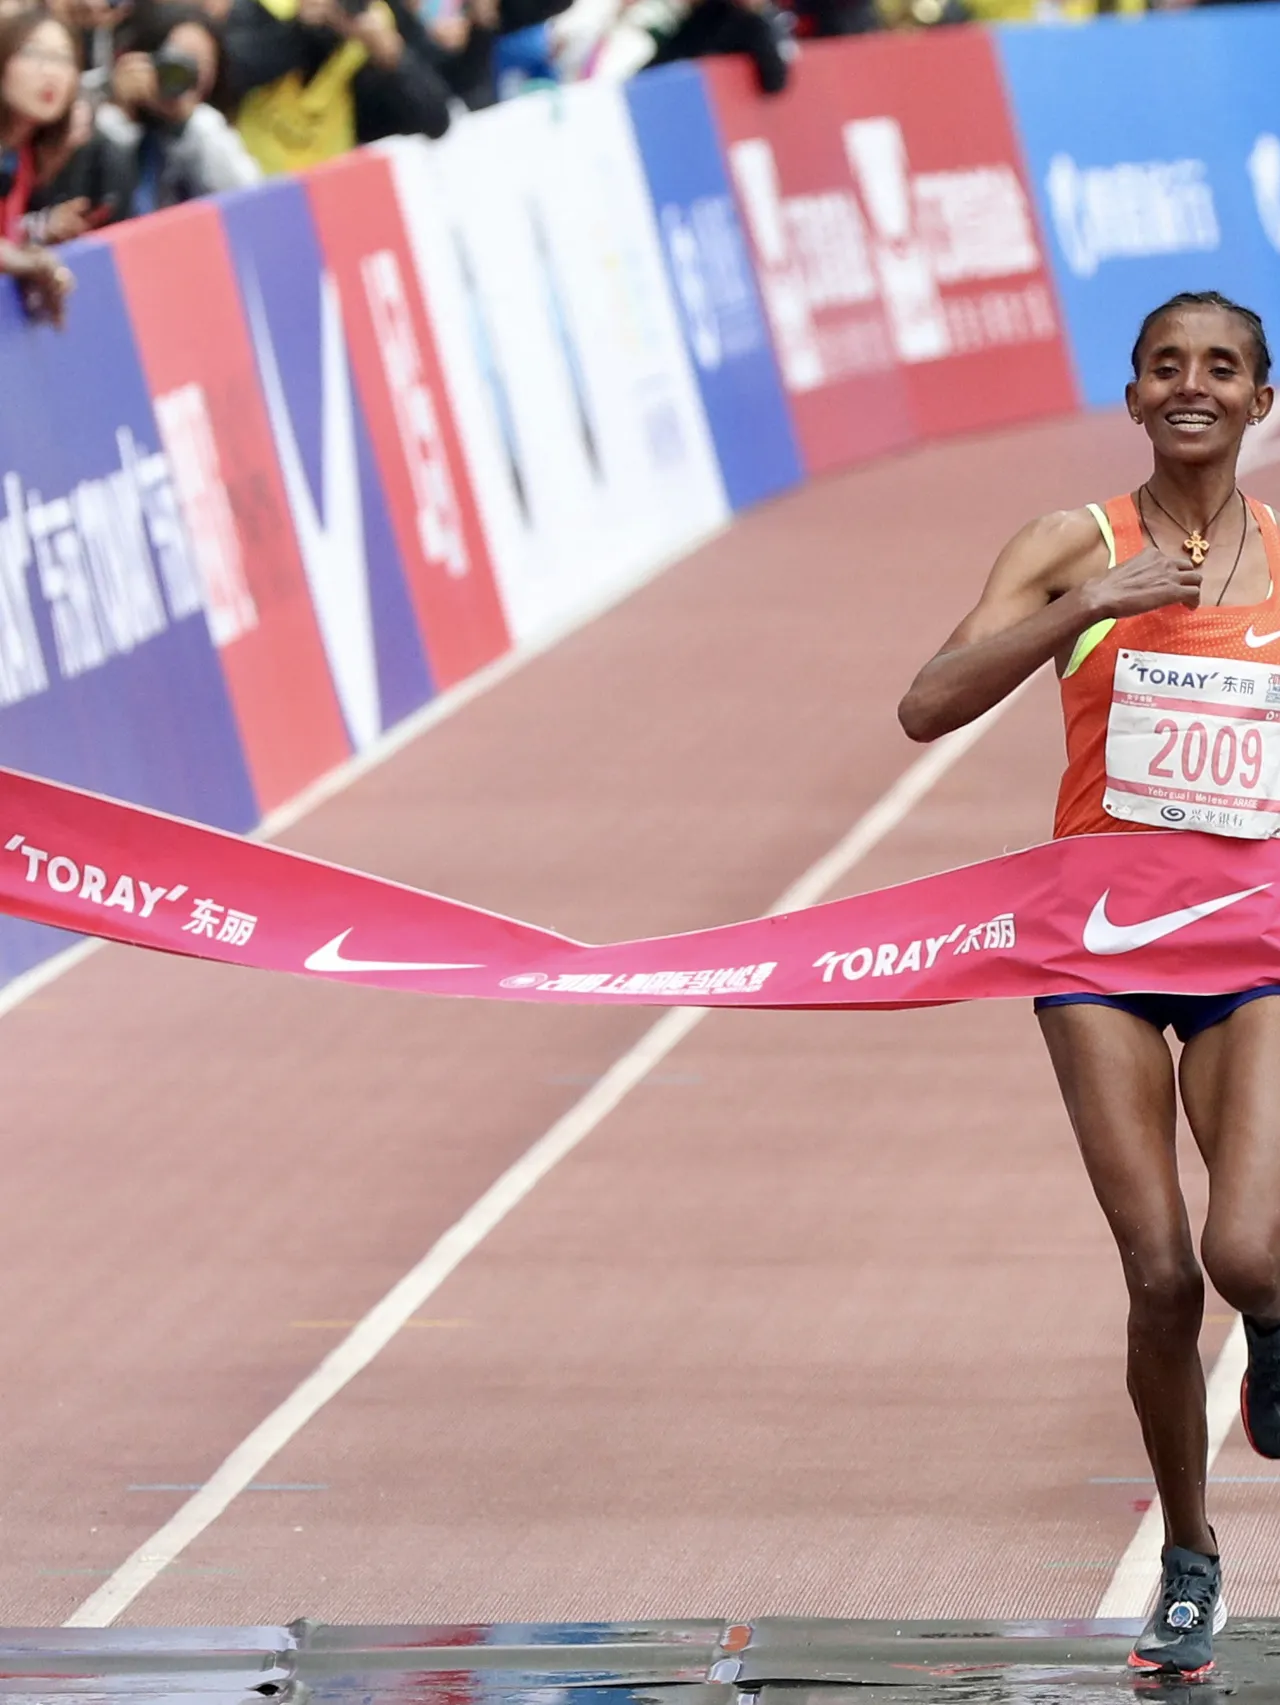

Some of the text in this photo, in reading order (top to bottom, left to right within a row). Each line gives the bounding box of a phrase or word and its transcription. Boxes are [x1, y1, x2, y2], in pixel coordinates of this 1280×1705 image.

[1221, 676, 1255, 695] 东丽
[1148, 718, 1263, 789] 2009
[182, 897, 258, 947] 东丽
